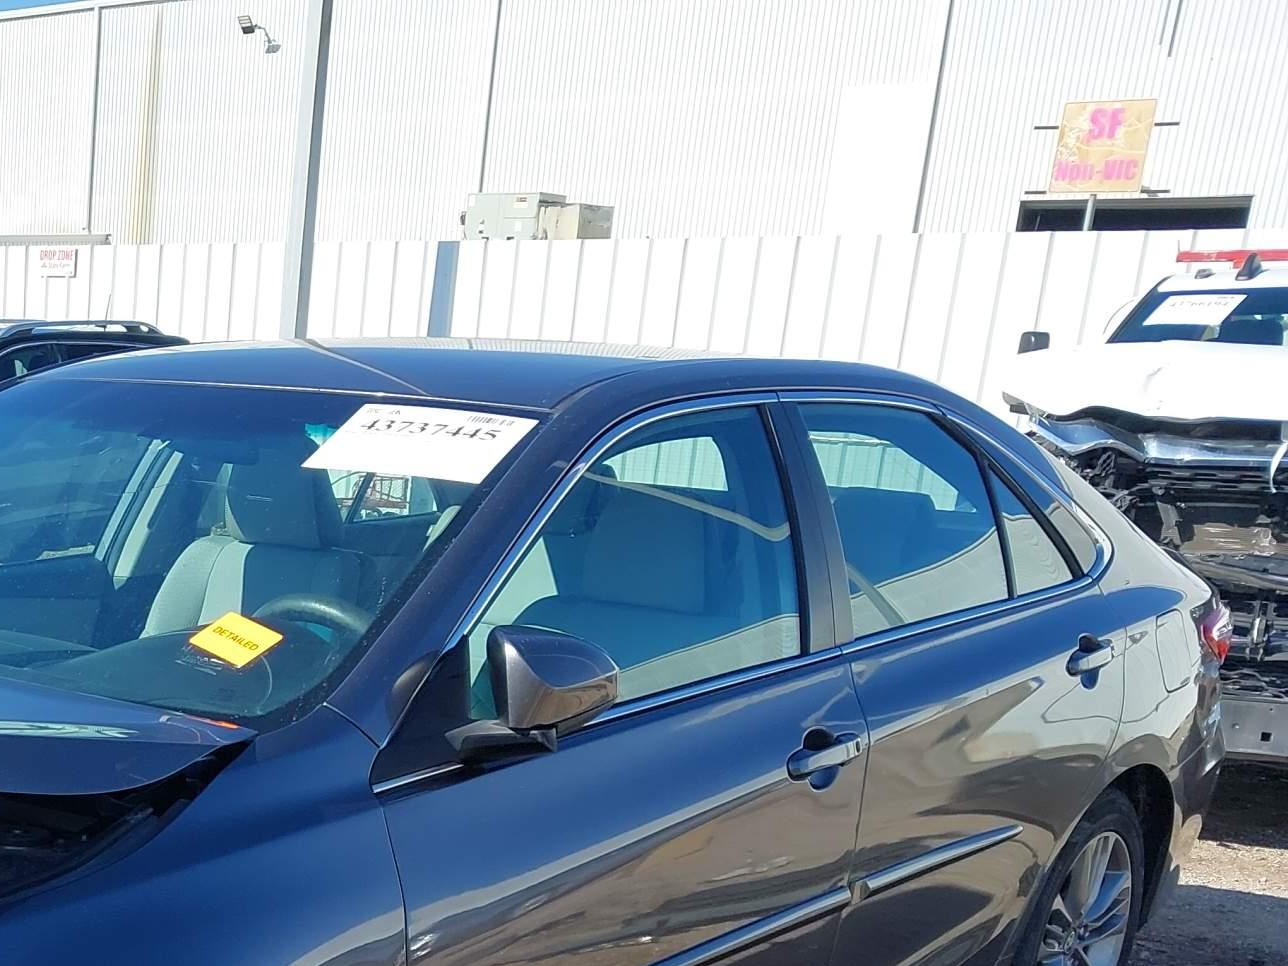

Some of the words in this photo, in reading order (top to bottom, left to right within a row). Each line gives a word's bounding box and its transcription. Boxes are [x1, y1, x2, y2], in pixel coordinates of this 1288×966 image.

[1089, 108, 1125, 139] SF
[1054, 159, 1138, 182] Non-VIC
[40, 249, 56, 261] DROP
[57, 249, 74, 261] ZONE
[360, 419, 501, 440] 43737445
[213, 626, 259, 650] DETAILED
